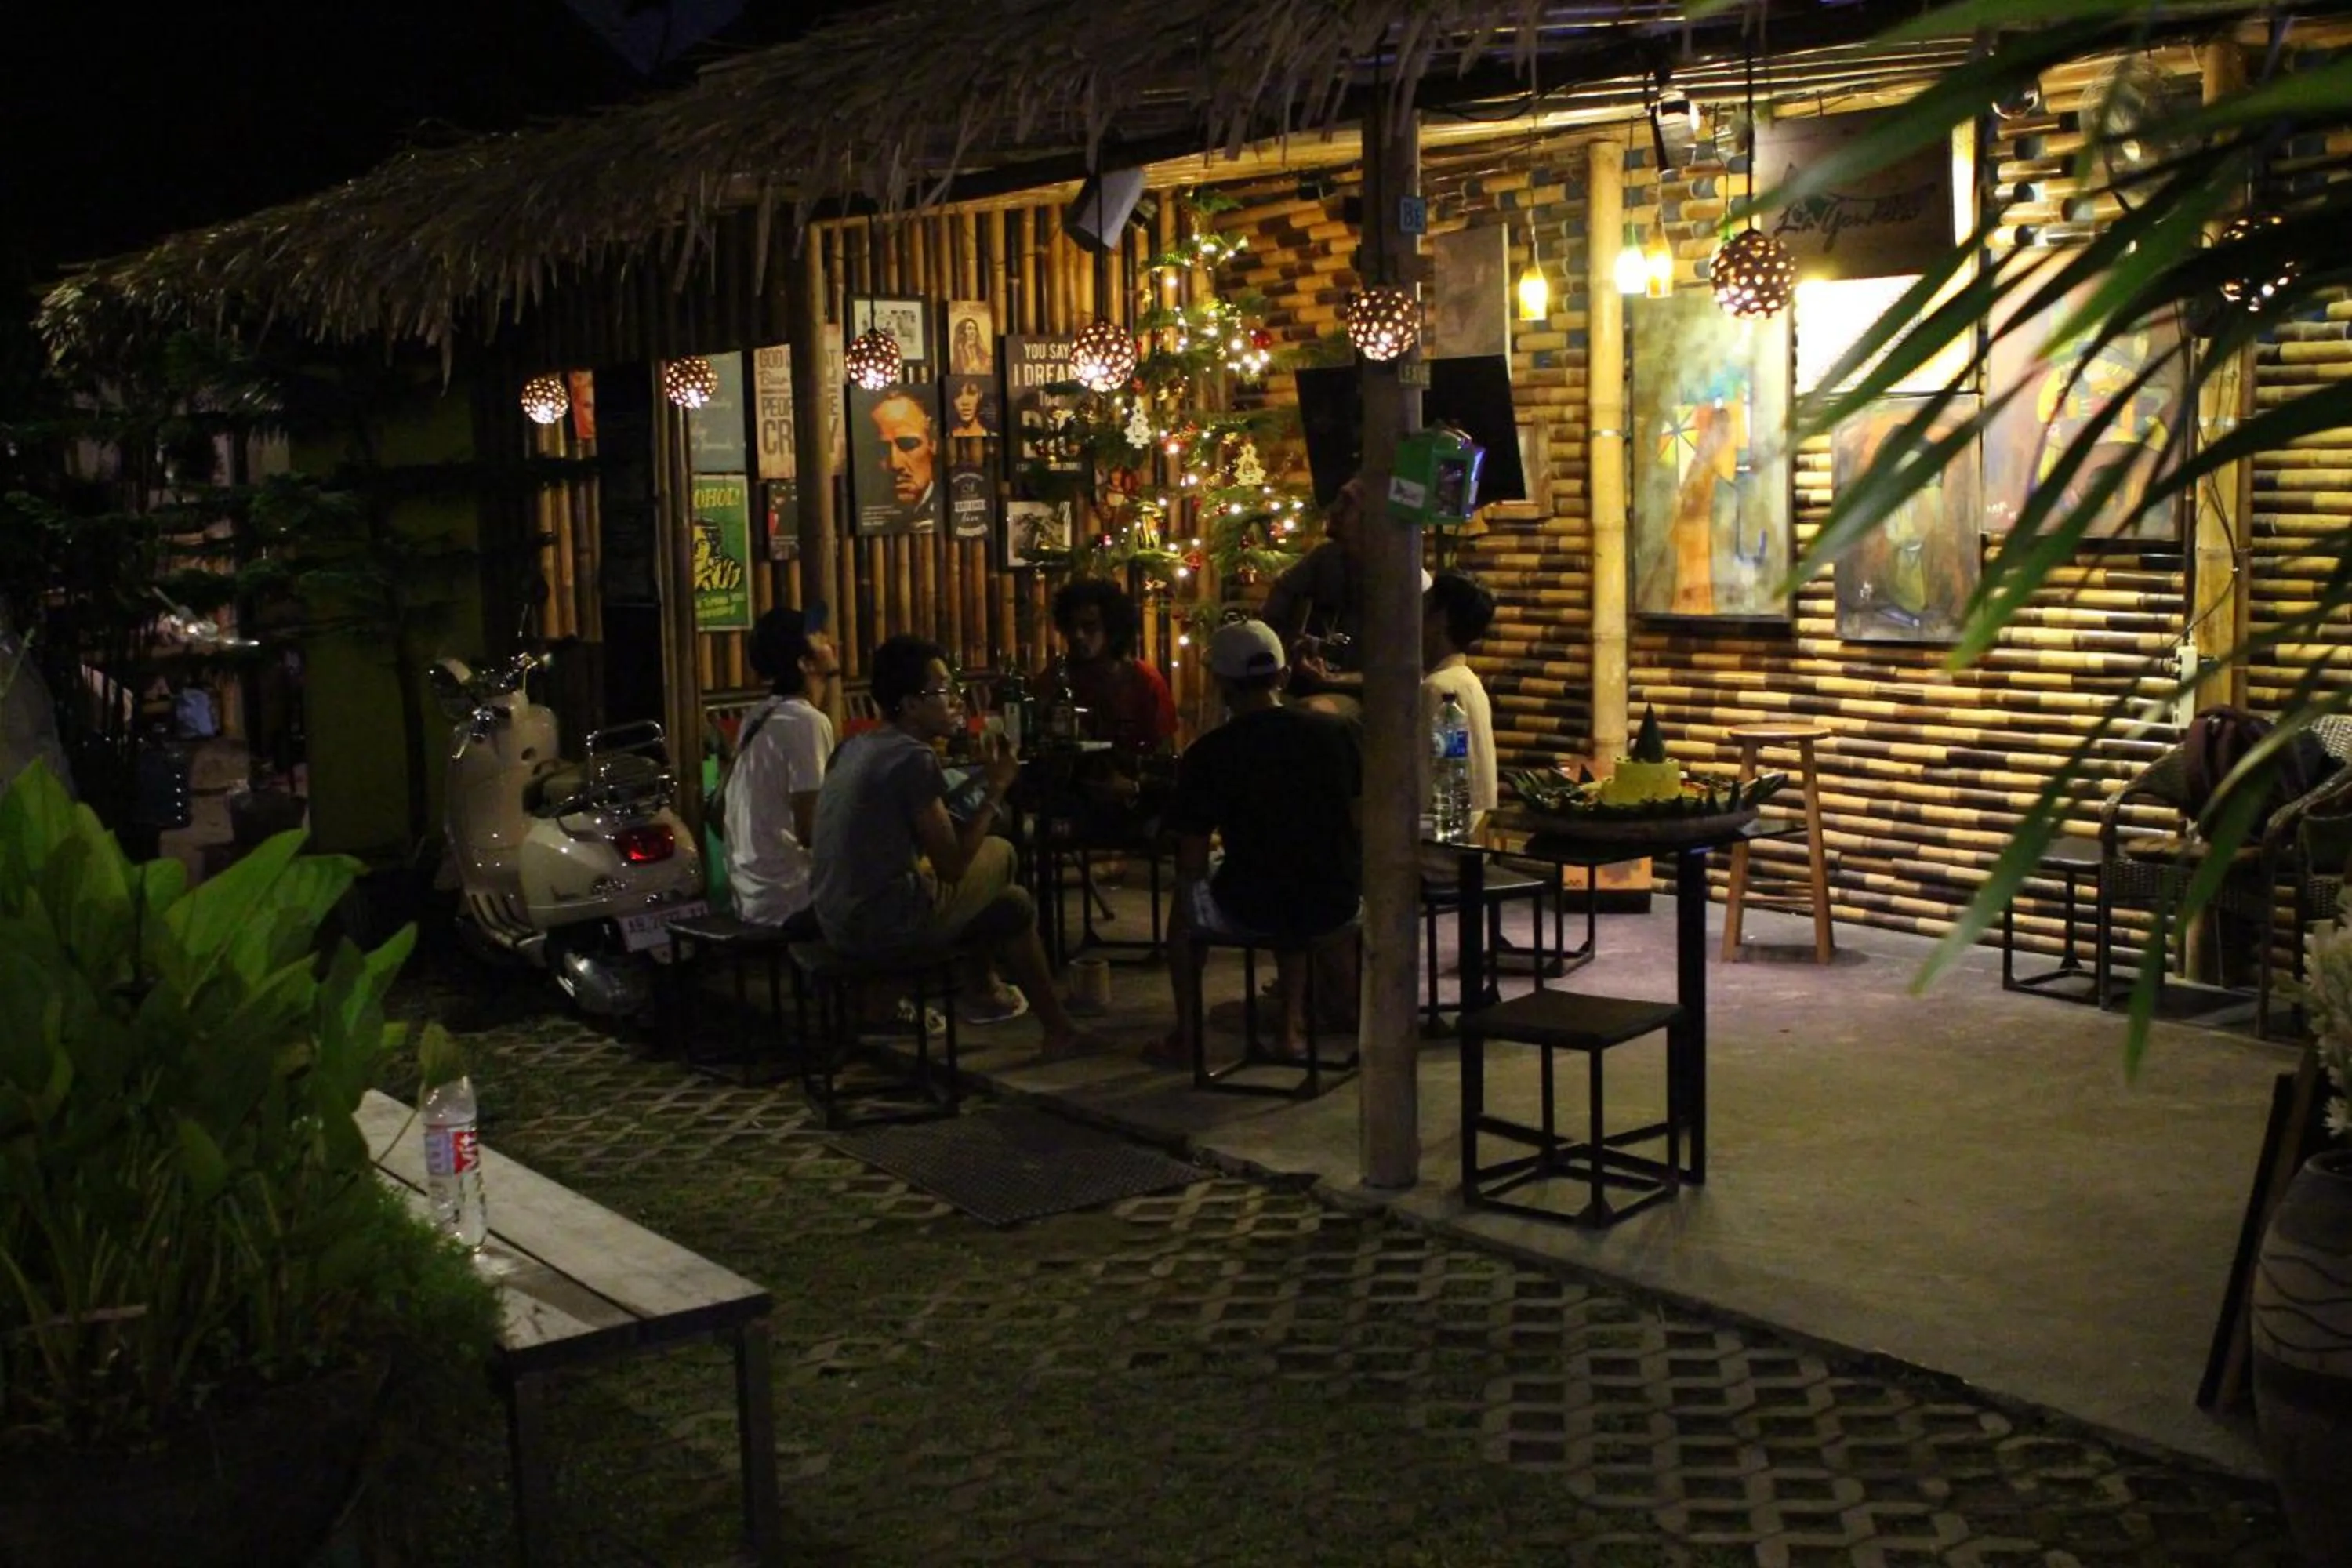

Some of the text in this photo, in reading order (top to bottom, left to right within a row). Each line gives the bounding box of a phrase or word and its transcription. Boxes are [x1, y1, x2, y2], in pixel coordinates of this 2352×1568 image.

[1024, 343, 1070, 359] YOU SAY
[1014, 363, 1019, 387] I
